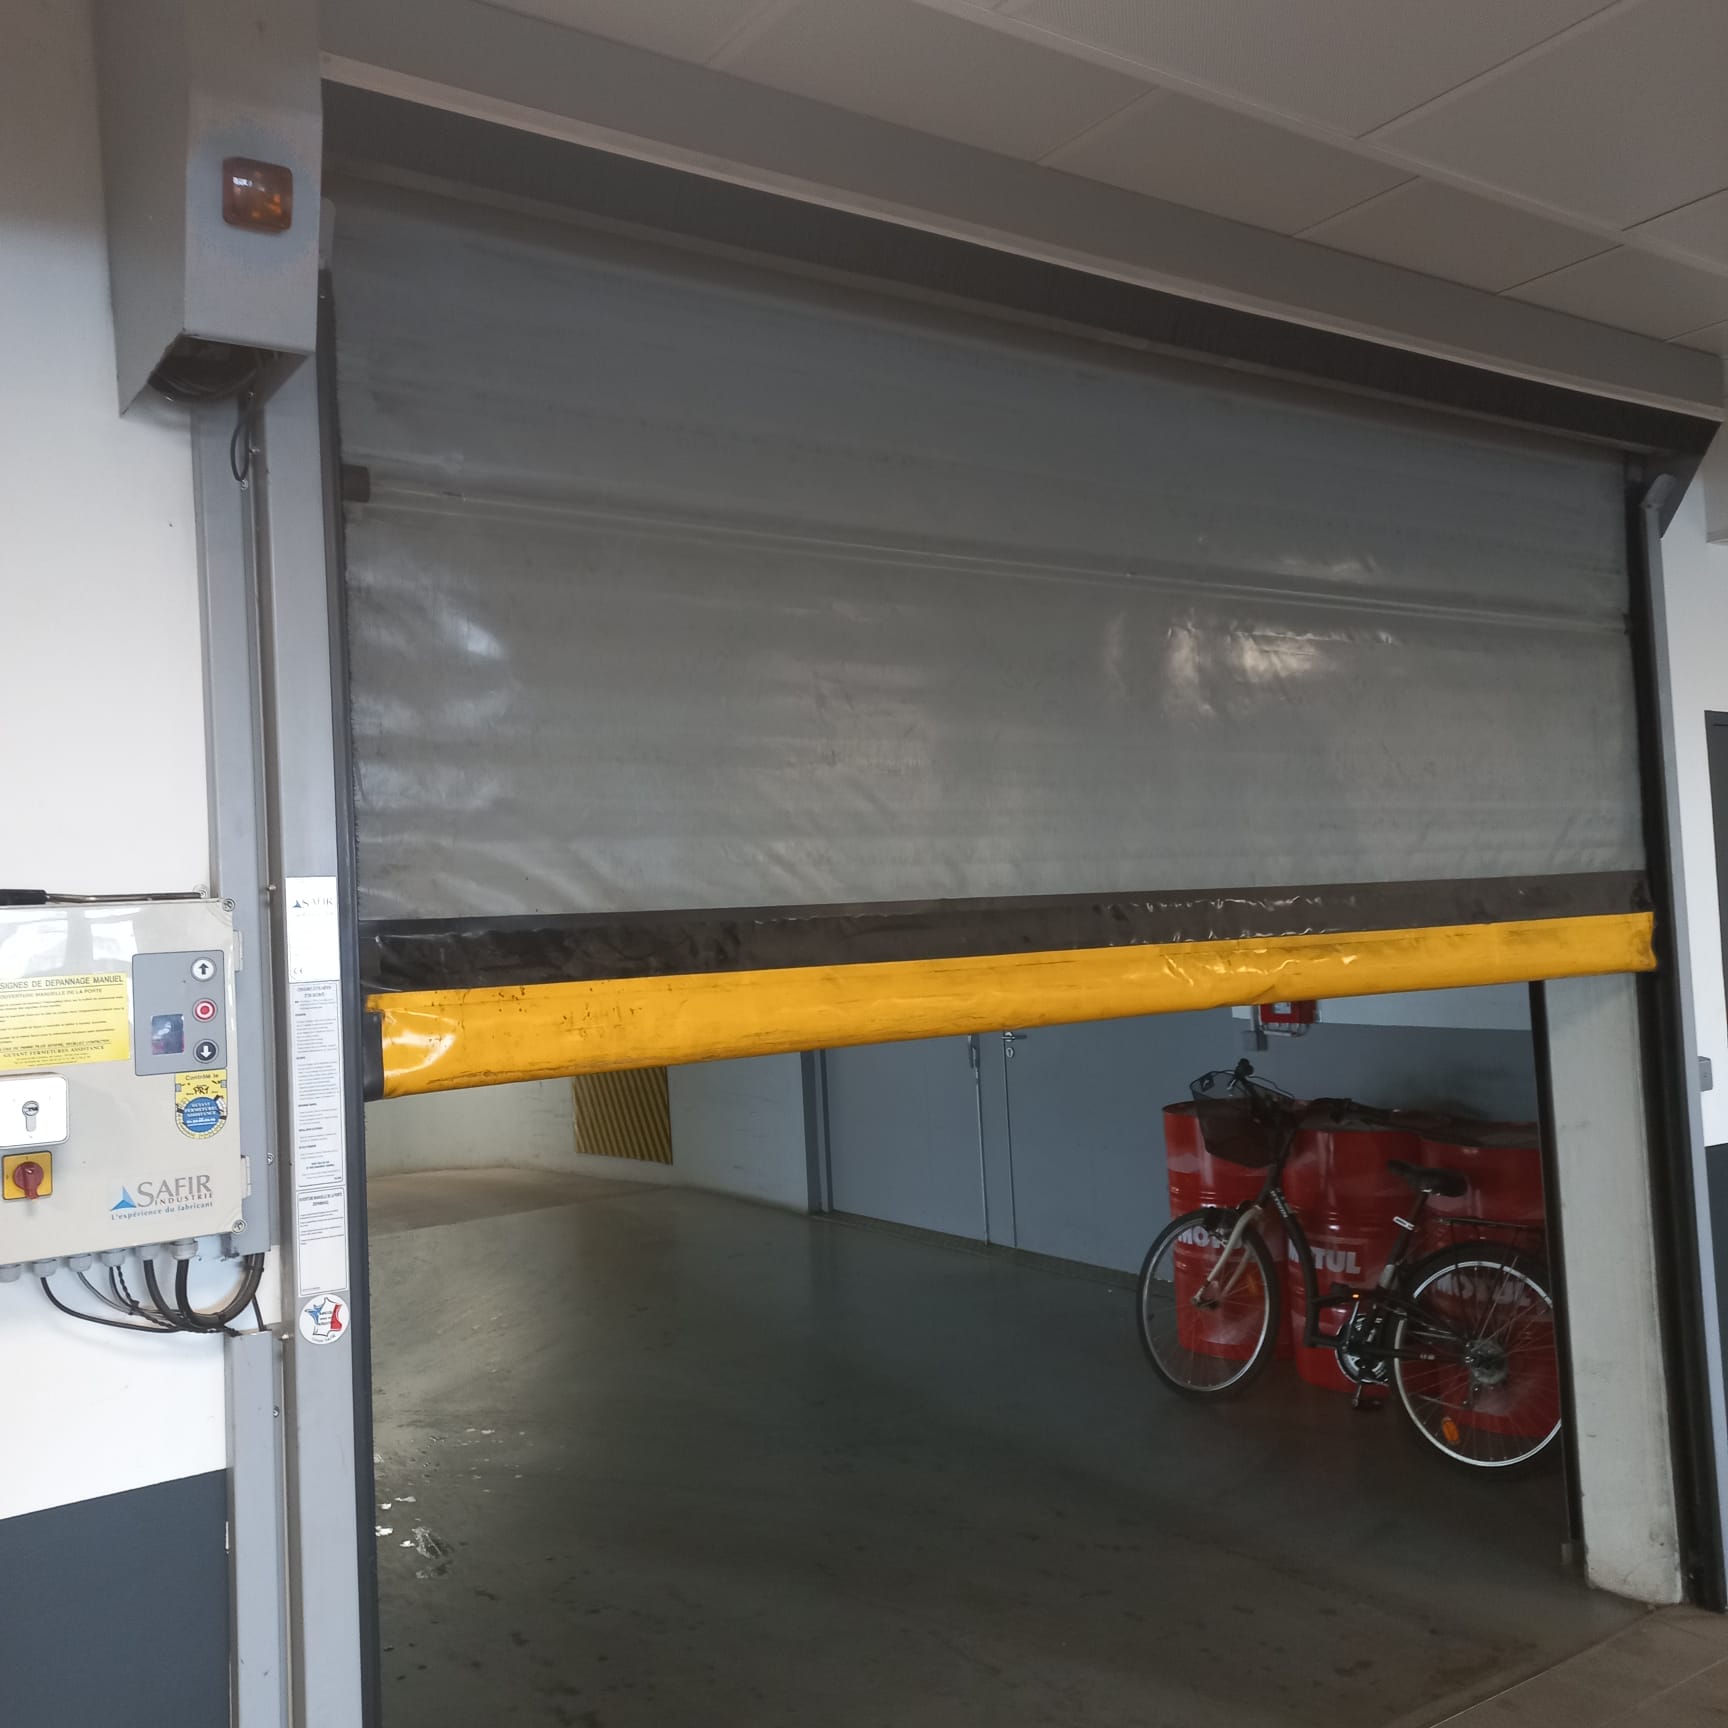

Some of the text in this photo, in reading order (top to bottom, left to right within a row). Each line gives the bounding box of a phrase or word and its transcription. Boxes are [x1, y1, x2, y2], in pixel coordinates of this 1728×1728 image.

[32, 980, 42, 988] DE
[93, 975, 123, 984] MANUEL
[137, 1174, 212, 1208] SAFIR
[154, 1193, 213, 1206] INDUSTRIE
[165, 1205, 175, 1214] du
[177, 1201, 213, 1212] fabricant
[1288, 1238, 1362, 1275] MTUL
